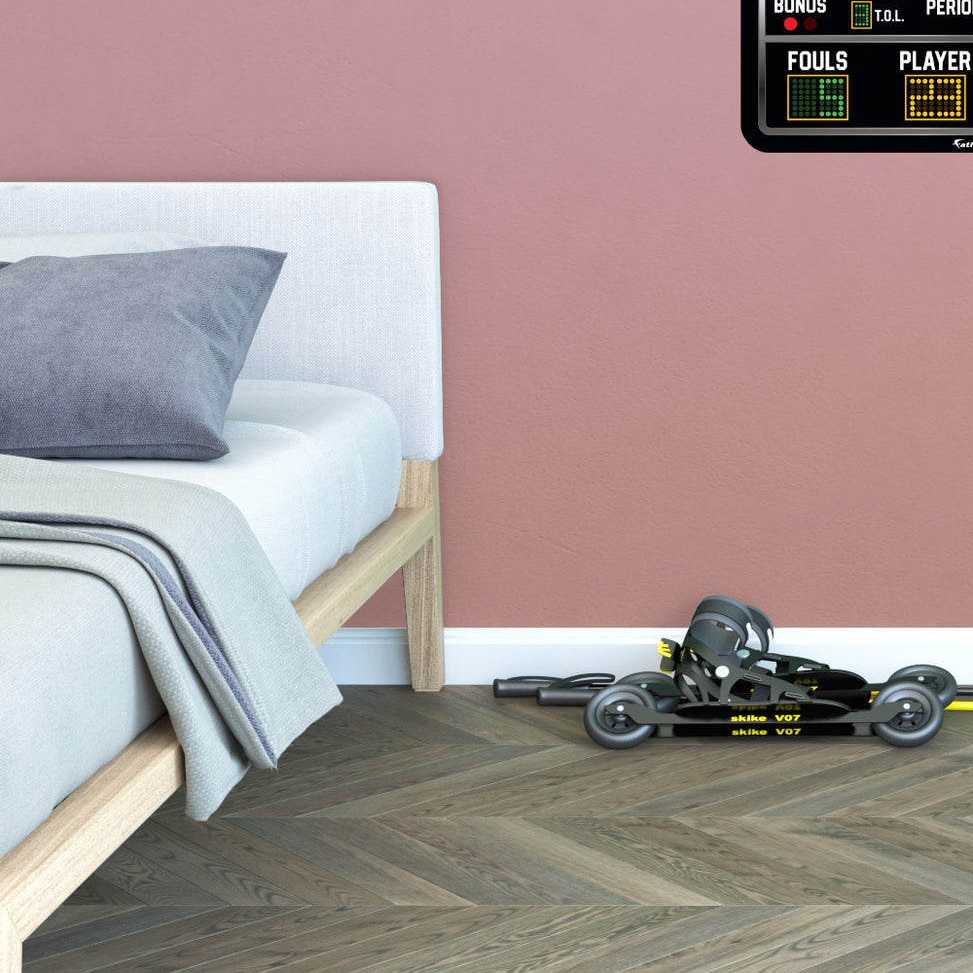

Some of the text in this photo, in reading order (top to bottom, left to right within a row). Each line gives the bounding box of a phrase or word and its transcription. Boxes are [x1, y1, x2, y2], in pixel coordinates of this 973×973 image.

[874, 9, 905, 22] T.O.L.
[788, 50, 848, 71] FOULS
[900, 50, 971, 71] PLAYER
[909, 78, 962, 117] 23
[731, 714, 801, 722] skike V07
[732, 728, 801, 736] skike V07
